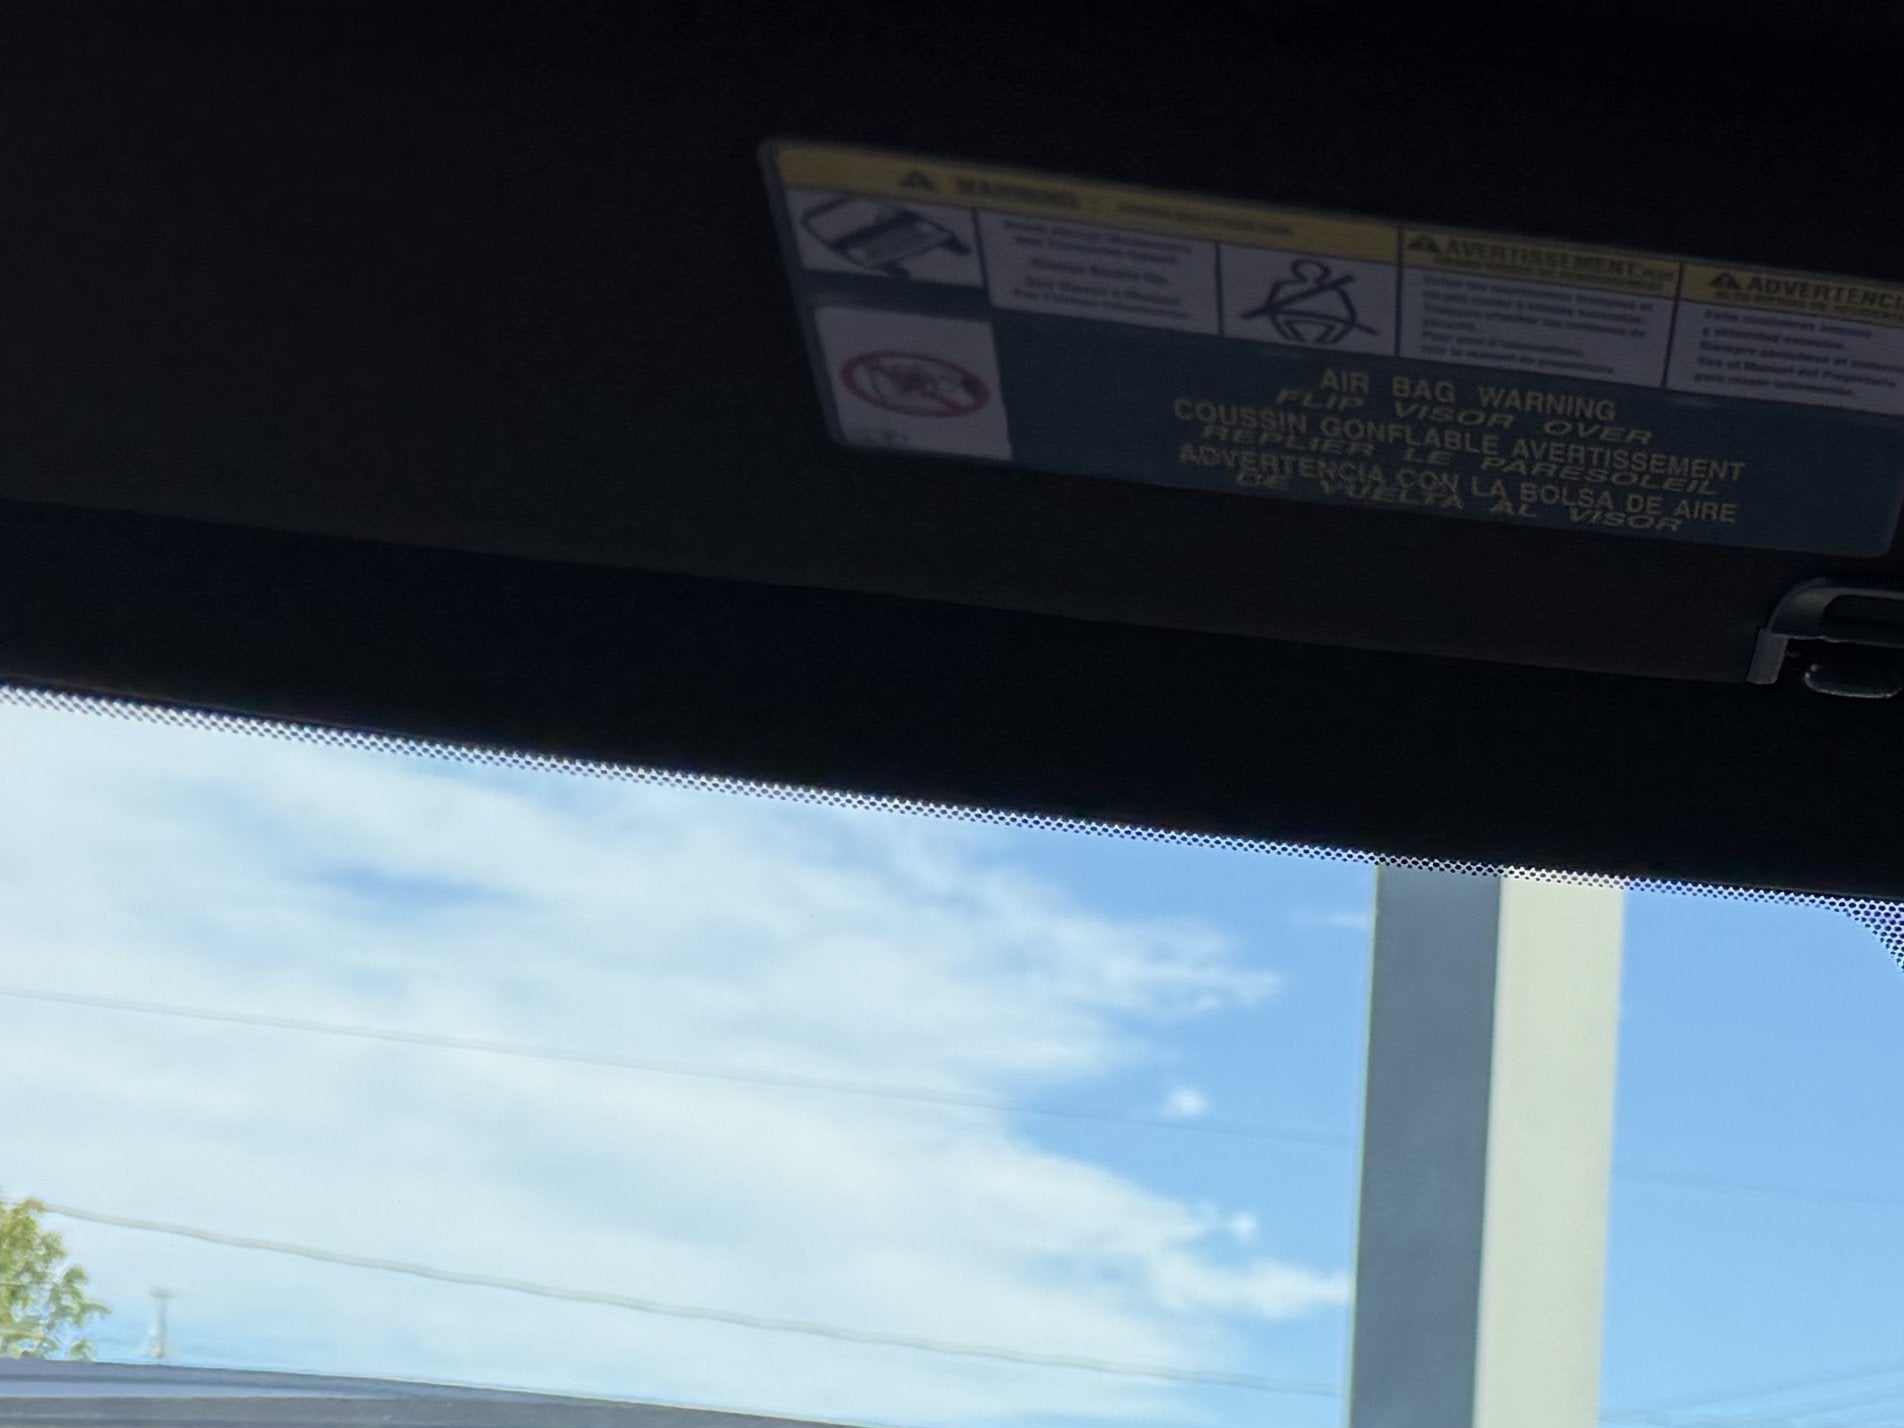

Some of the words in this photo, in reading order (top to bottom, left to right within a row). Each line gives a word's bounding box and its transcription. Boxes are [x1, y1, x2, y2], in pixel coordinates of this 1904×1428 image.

[1446, 239, 1637, 275] AVERTISSEMENT
[1278, 388, 1365, 411] FLIP
[1395, 401, 1516, 430] VISOR
[1543, 420, 1653, 445] OVER
[1320, 368, 1370, 395] AIR
[1392, 376, 1456, 403] BAG
[1477, 385, 1617, 421] WARNING
[1173, 398, 1308, 434] COUSSIN
[1320, 416, 1500, 456] GONFLABLE
[1511, 438, 1745, 482] AVERTISSEMENT
[1200, 425, 1376, 457] REPLIER
[1403, 447, 1455, 466] LE
[1480, 457, 1717, 496] PARESOLEIL
[1179, 443, 1387, 485] ADVERTENCIA
[1396, 468, 1460, 495] CON
[1470, 476, 1506, 498] LA
[1519, 481, 1614, 511] BOLSA
[1625, 494, 1664, 515] DE
[1673, 499, 1740, 523] AIRE
[1567, 507, 1684, 532] VISOR
